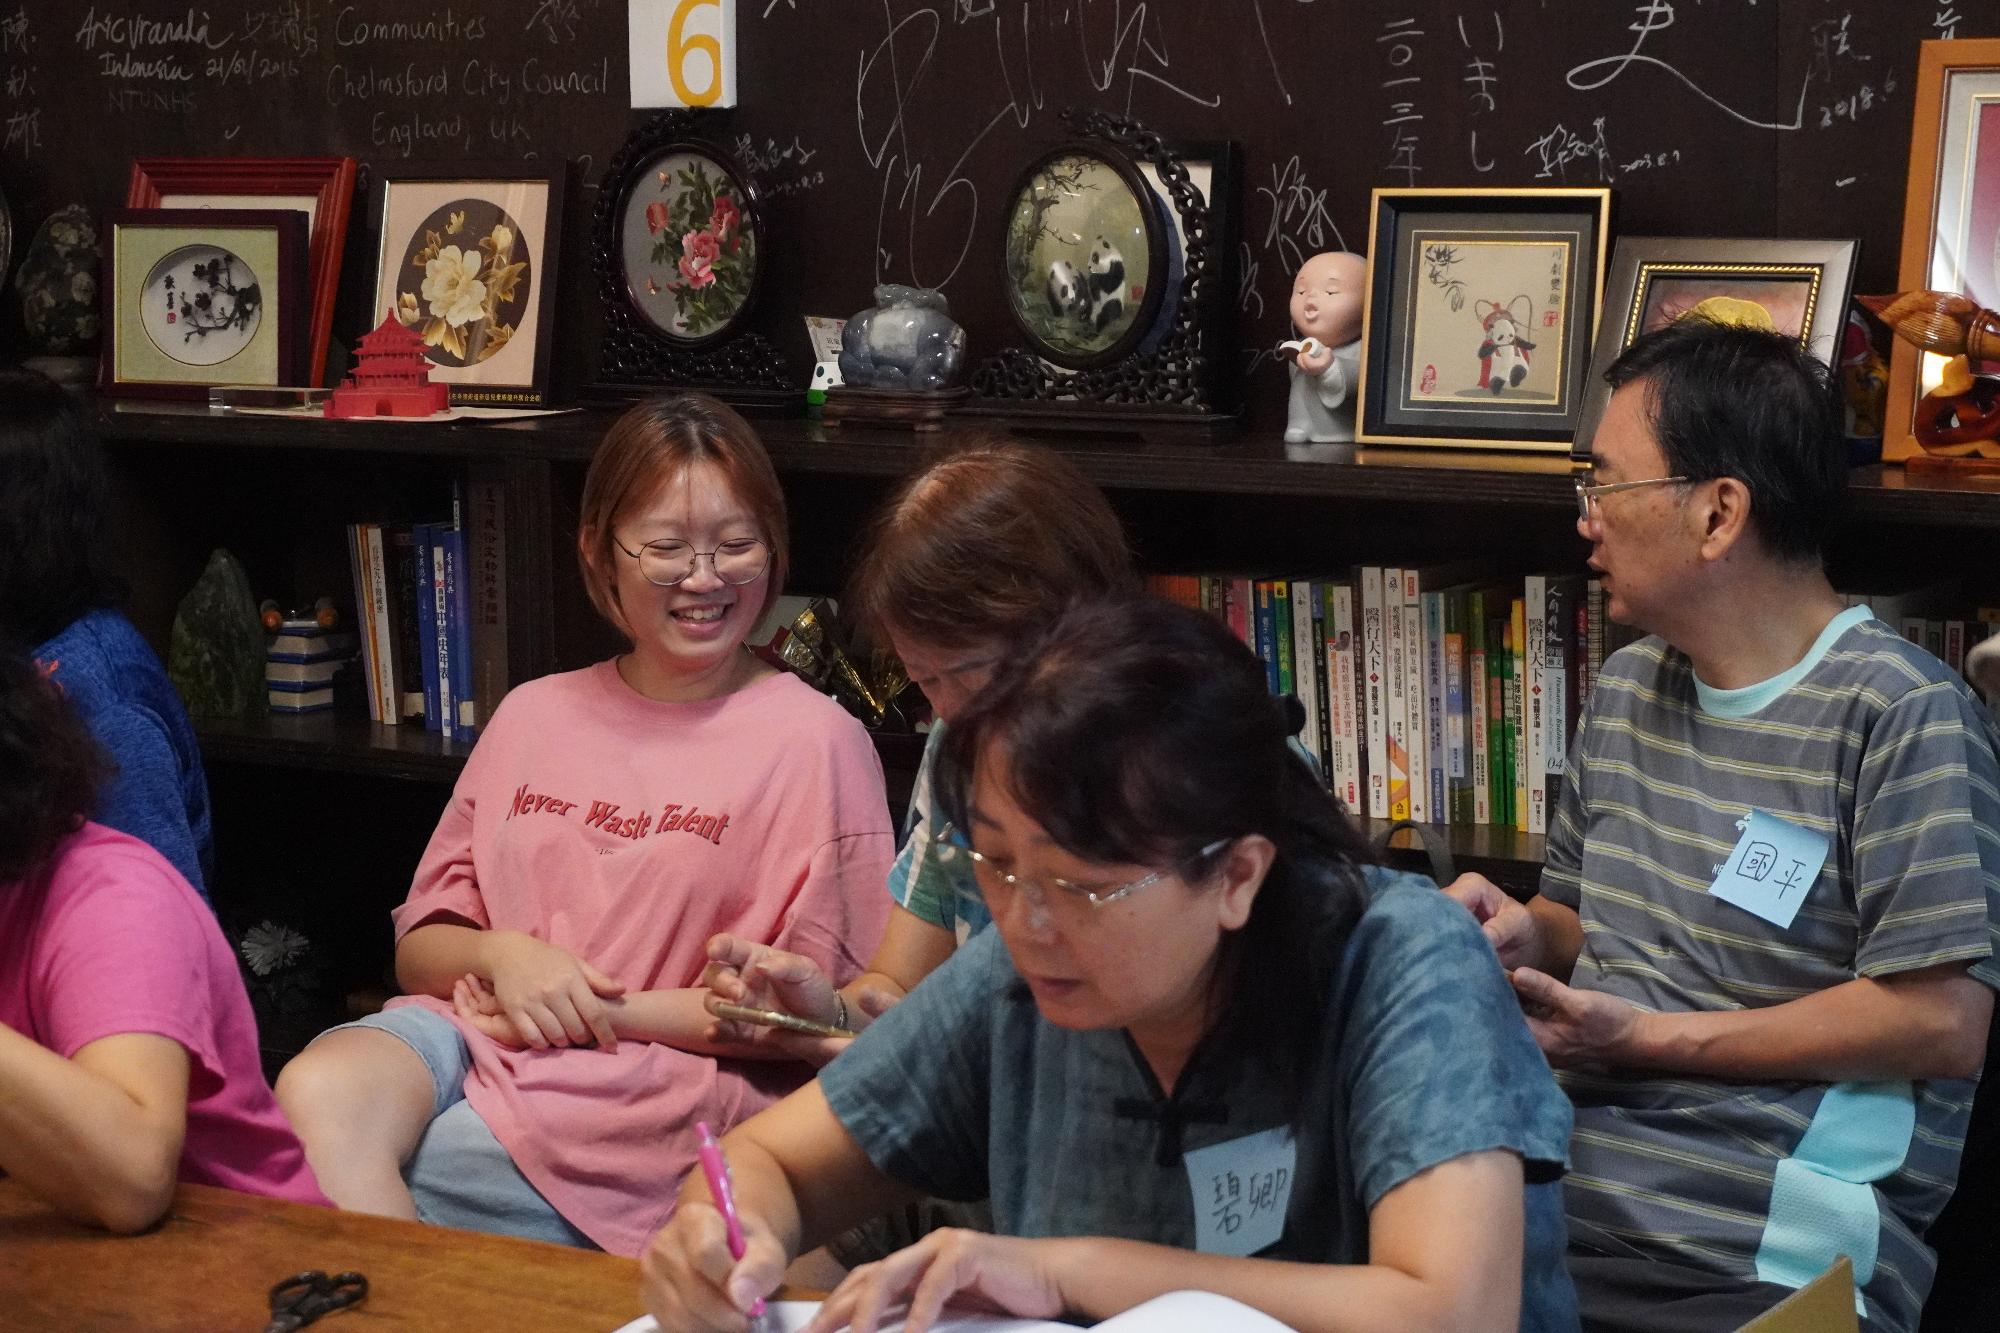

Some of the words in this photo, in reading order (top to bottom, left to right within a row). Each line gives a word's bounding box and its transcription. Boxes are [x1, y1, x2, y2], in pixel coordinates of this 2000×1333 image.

[336, 7, 486, 46] Communities
[668, 0, 723, 107] 6
[328, 63, 448, 105] Chelmsford
[464, 59, 510, 104] City
[523, 57, 608, 95] Council
[1365, 607, 1380, 671] 醫行天下
[1528, 618, 1544, 683] 醫行天下
[1547, 758, 1564, 769] 04
[506, 783, 578, 821] Never
[584, 800, 652, 840] Waste
[655, 803, 730, 845] Talent
